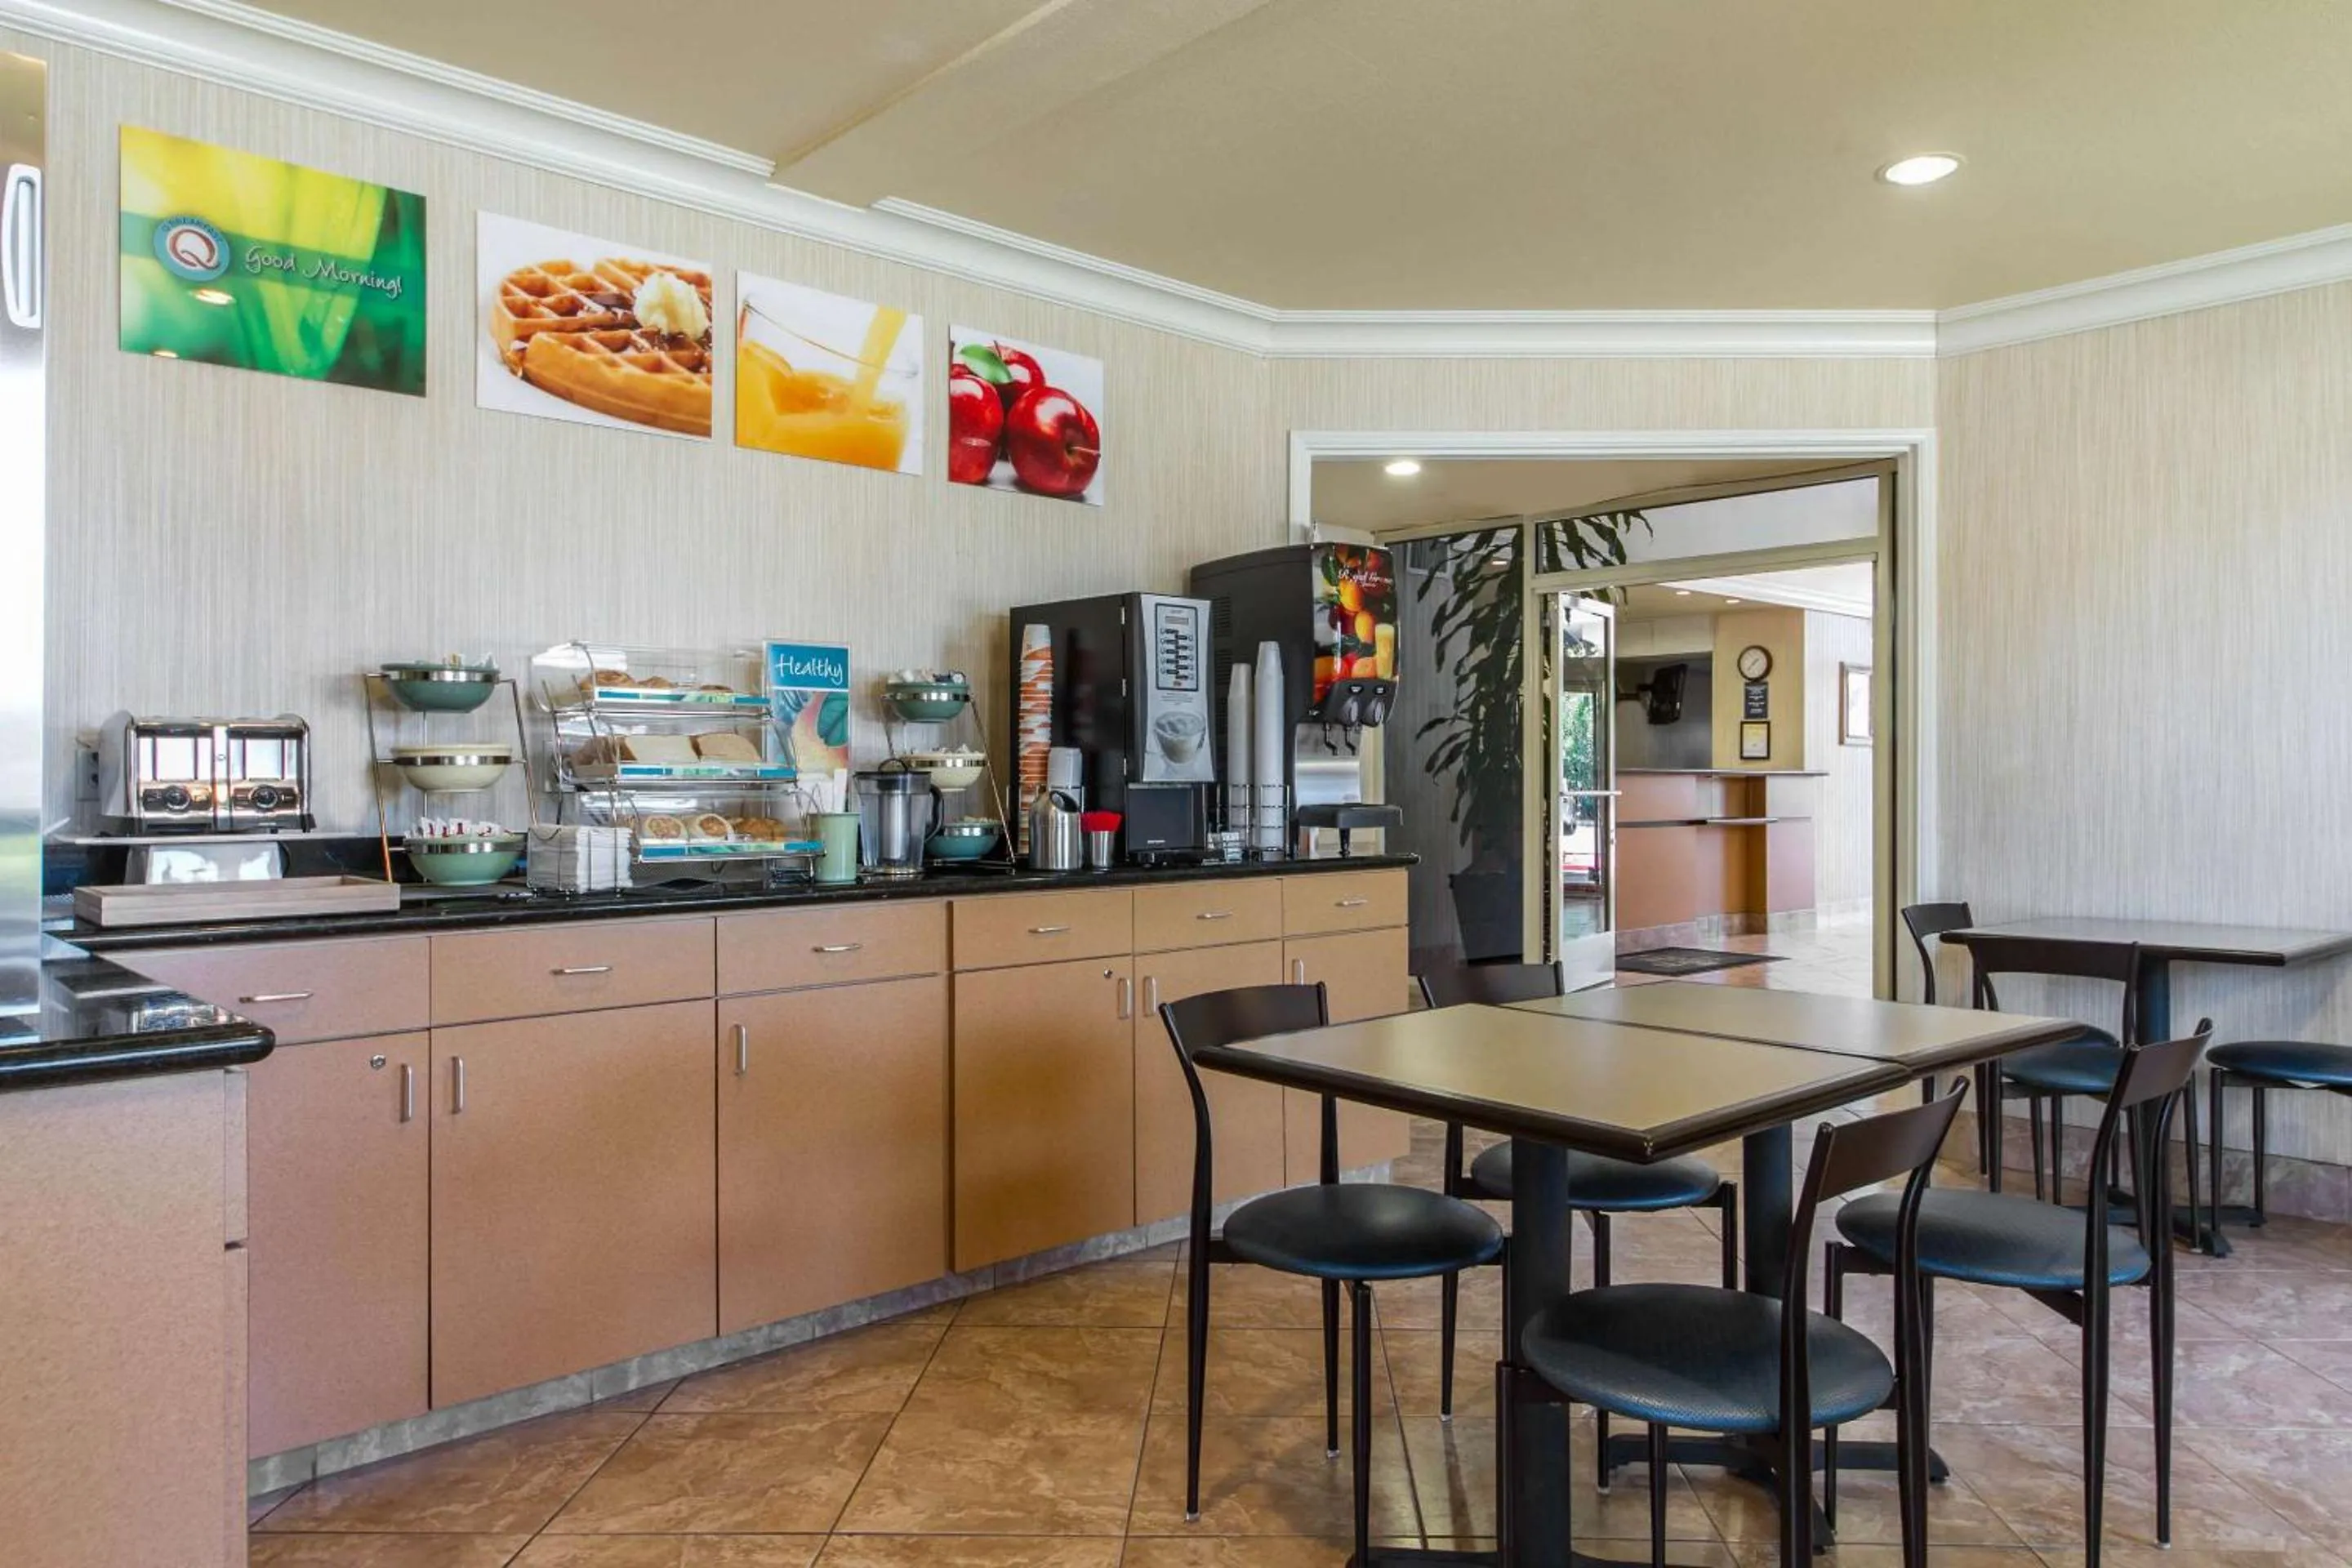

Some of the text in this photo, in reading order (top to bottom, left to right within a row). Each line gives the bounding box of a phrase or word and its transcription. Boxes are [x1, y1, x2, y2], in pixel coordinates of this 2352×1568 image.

[245, 245, 403, 300] Good Morning!
[774, 653, 843, 686] Healthy
